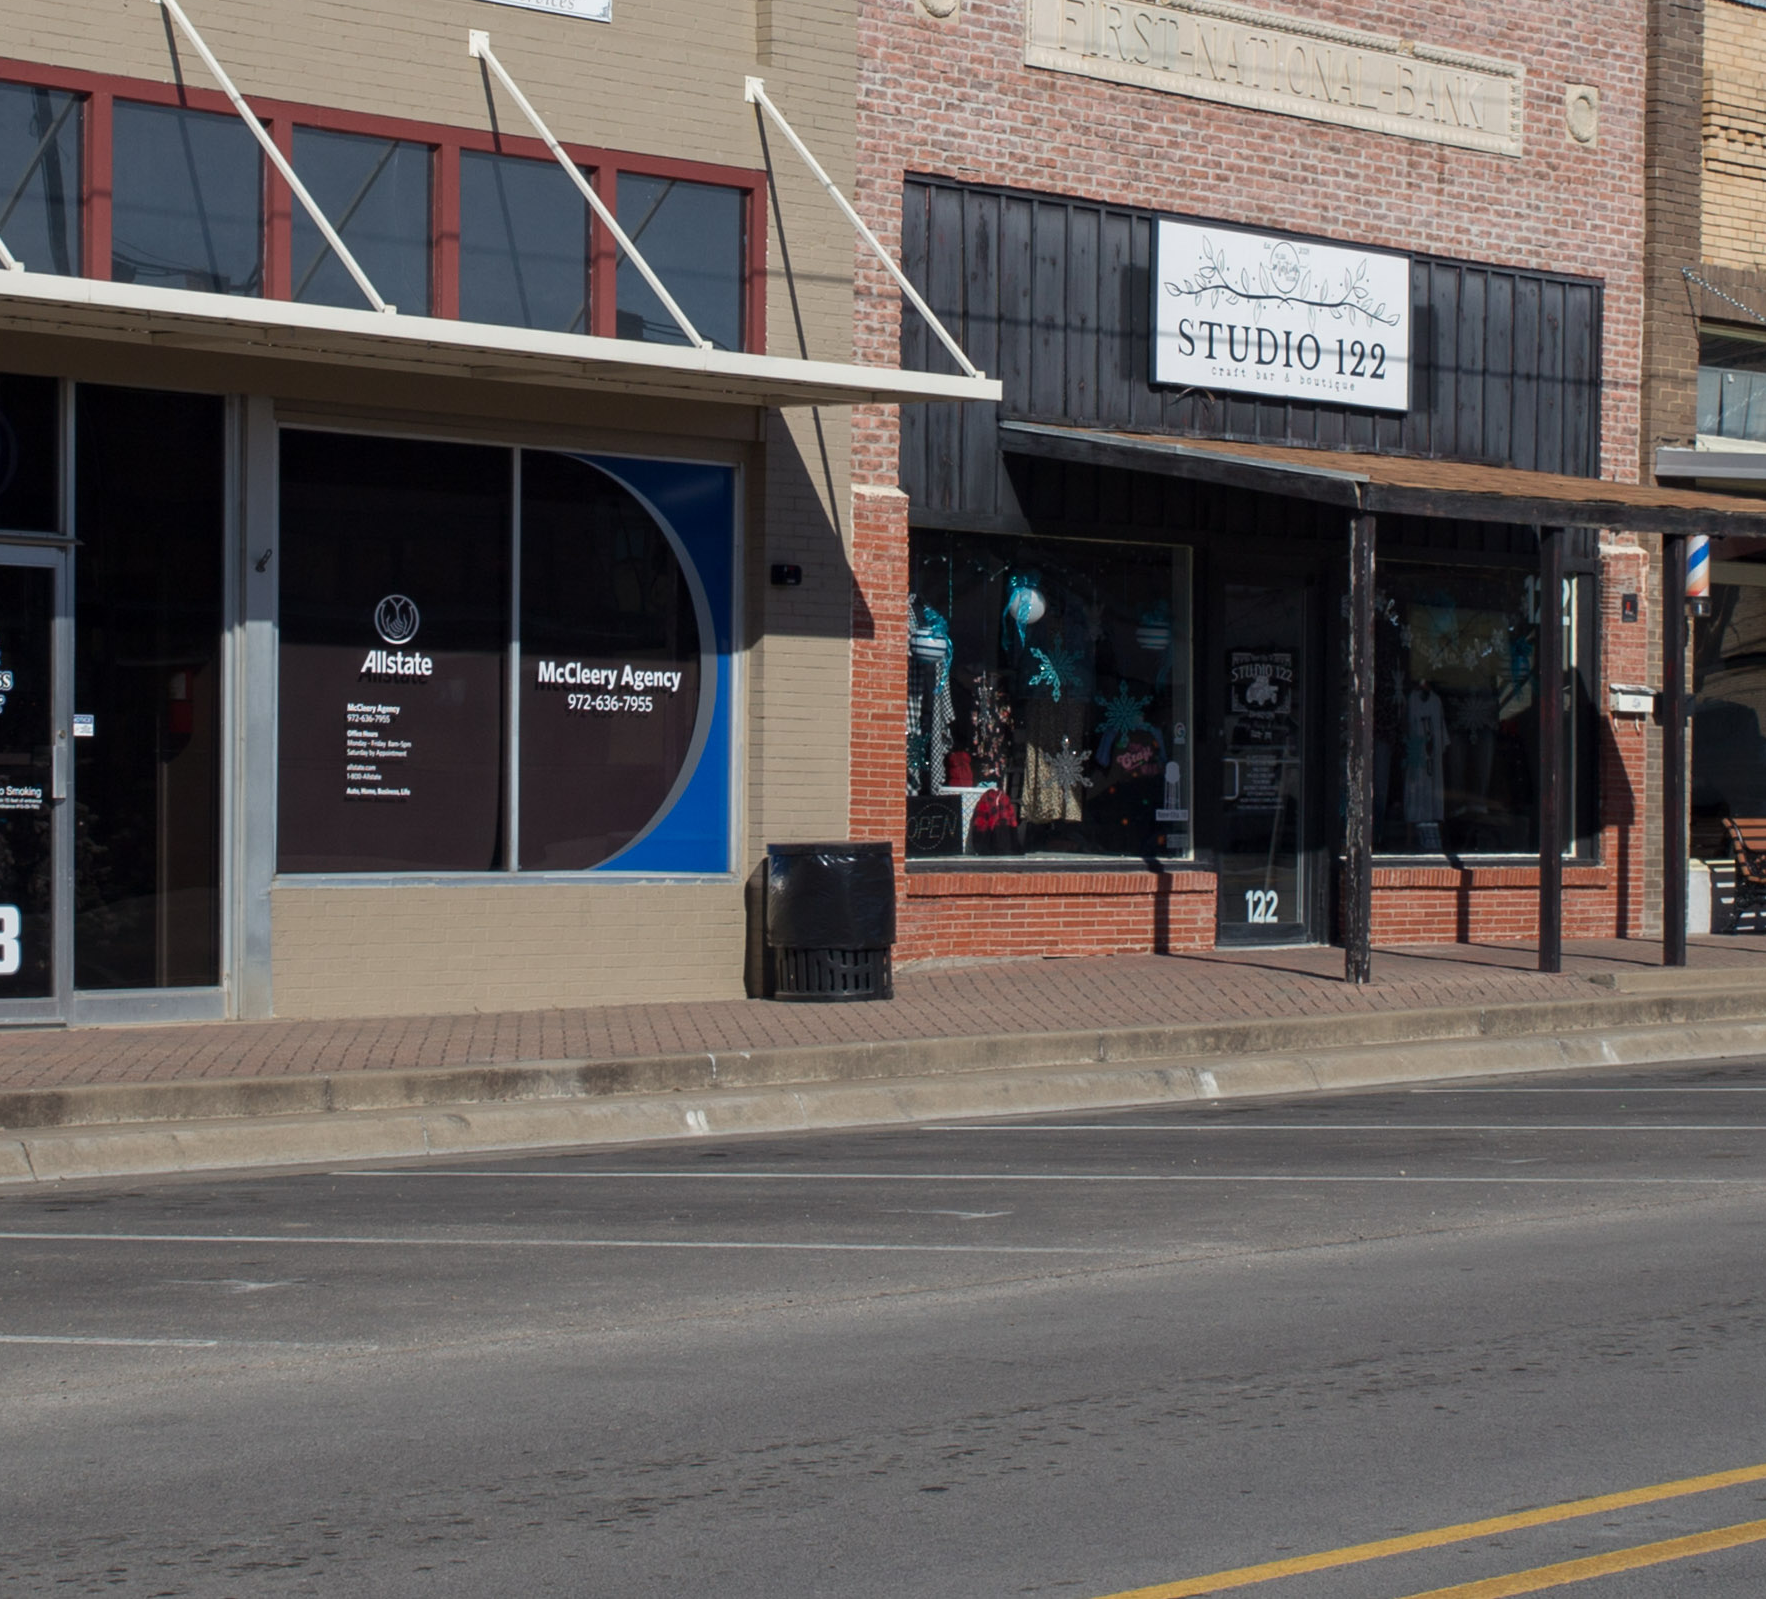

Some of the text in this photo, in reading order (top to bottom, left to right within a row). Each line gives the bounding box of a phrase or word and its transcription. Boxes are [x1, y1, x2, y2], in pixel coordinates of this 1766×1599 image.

[1177, 318, 1387, 381] STUDIO 122
[1300, 374, 1356, 393] boutique
[361, 650, 433, 676] Allstate
[1231, 663, 1294, 684] STUDIO 122
[538, 660, 682, 692] McCleery Agency
[347, 703, 401, 715] McCleery Agency
[567, 693, 653, 712] 972-636-7955
[5, 785, 42, 799] Smoking
[907, 814, 958, 840] OPEN
[1245, 889, 1279, 924] 122
